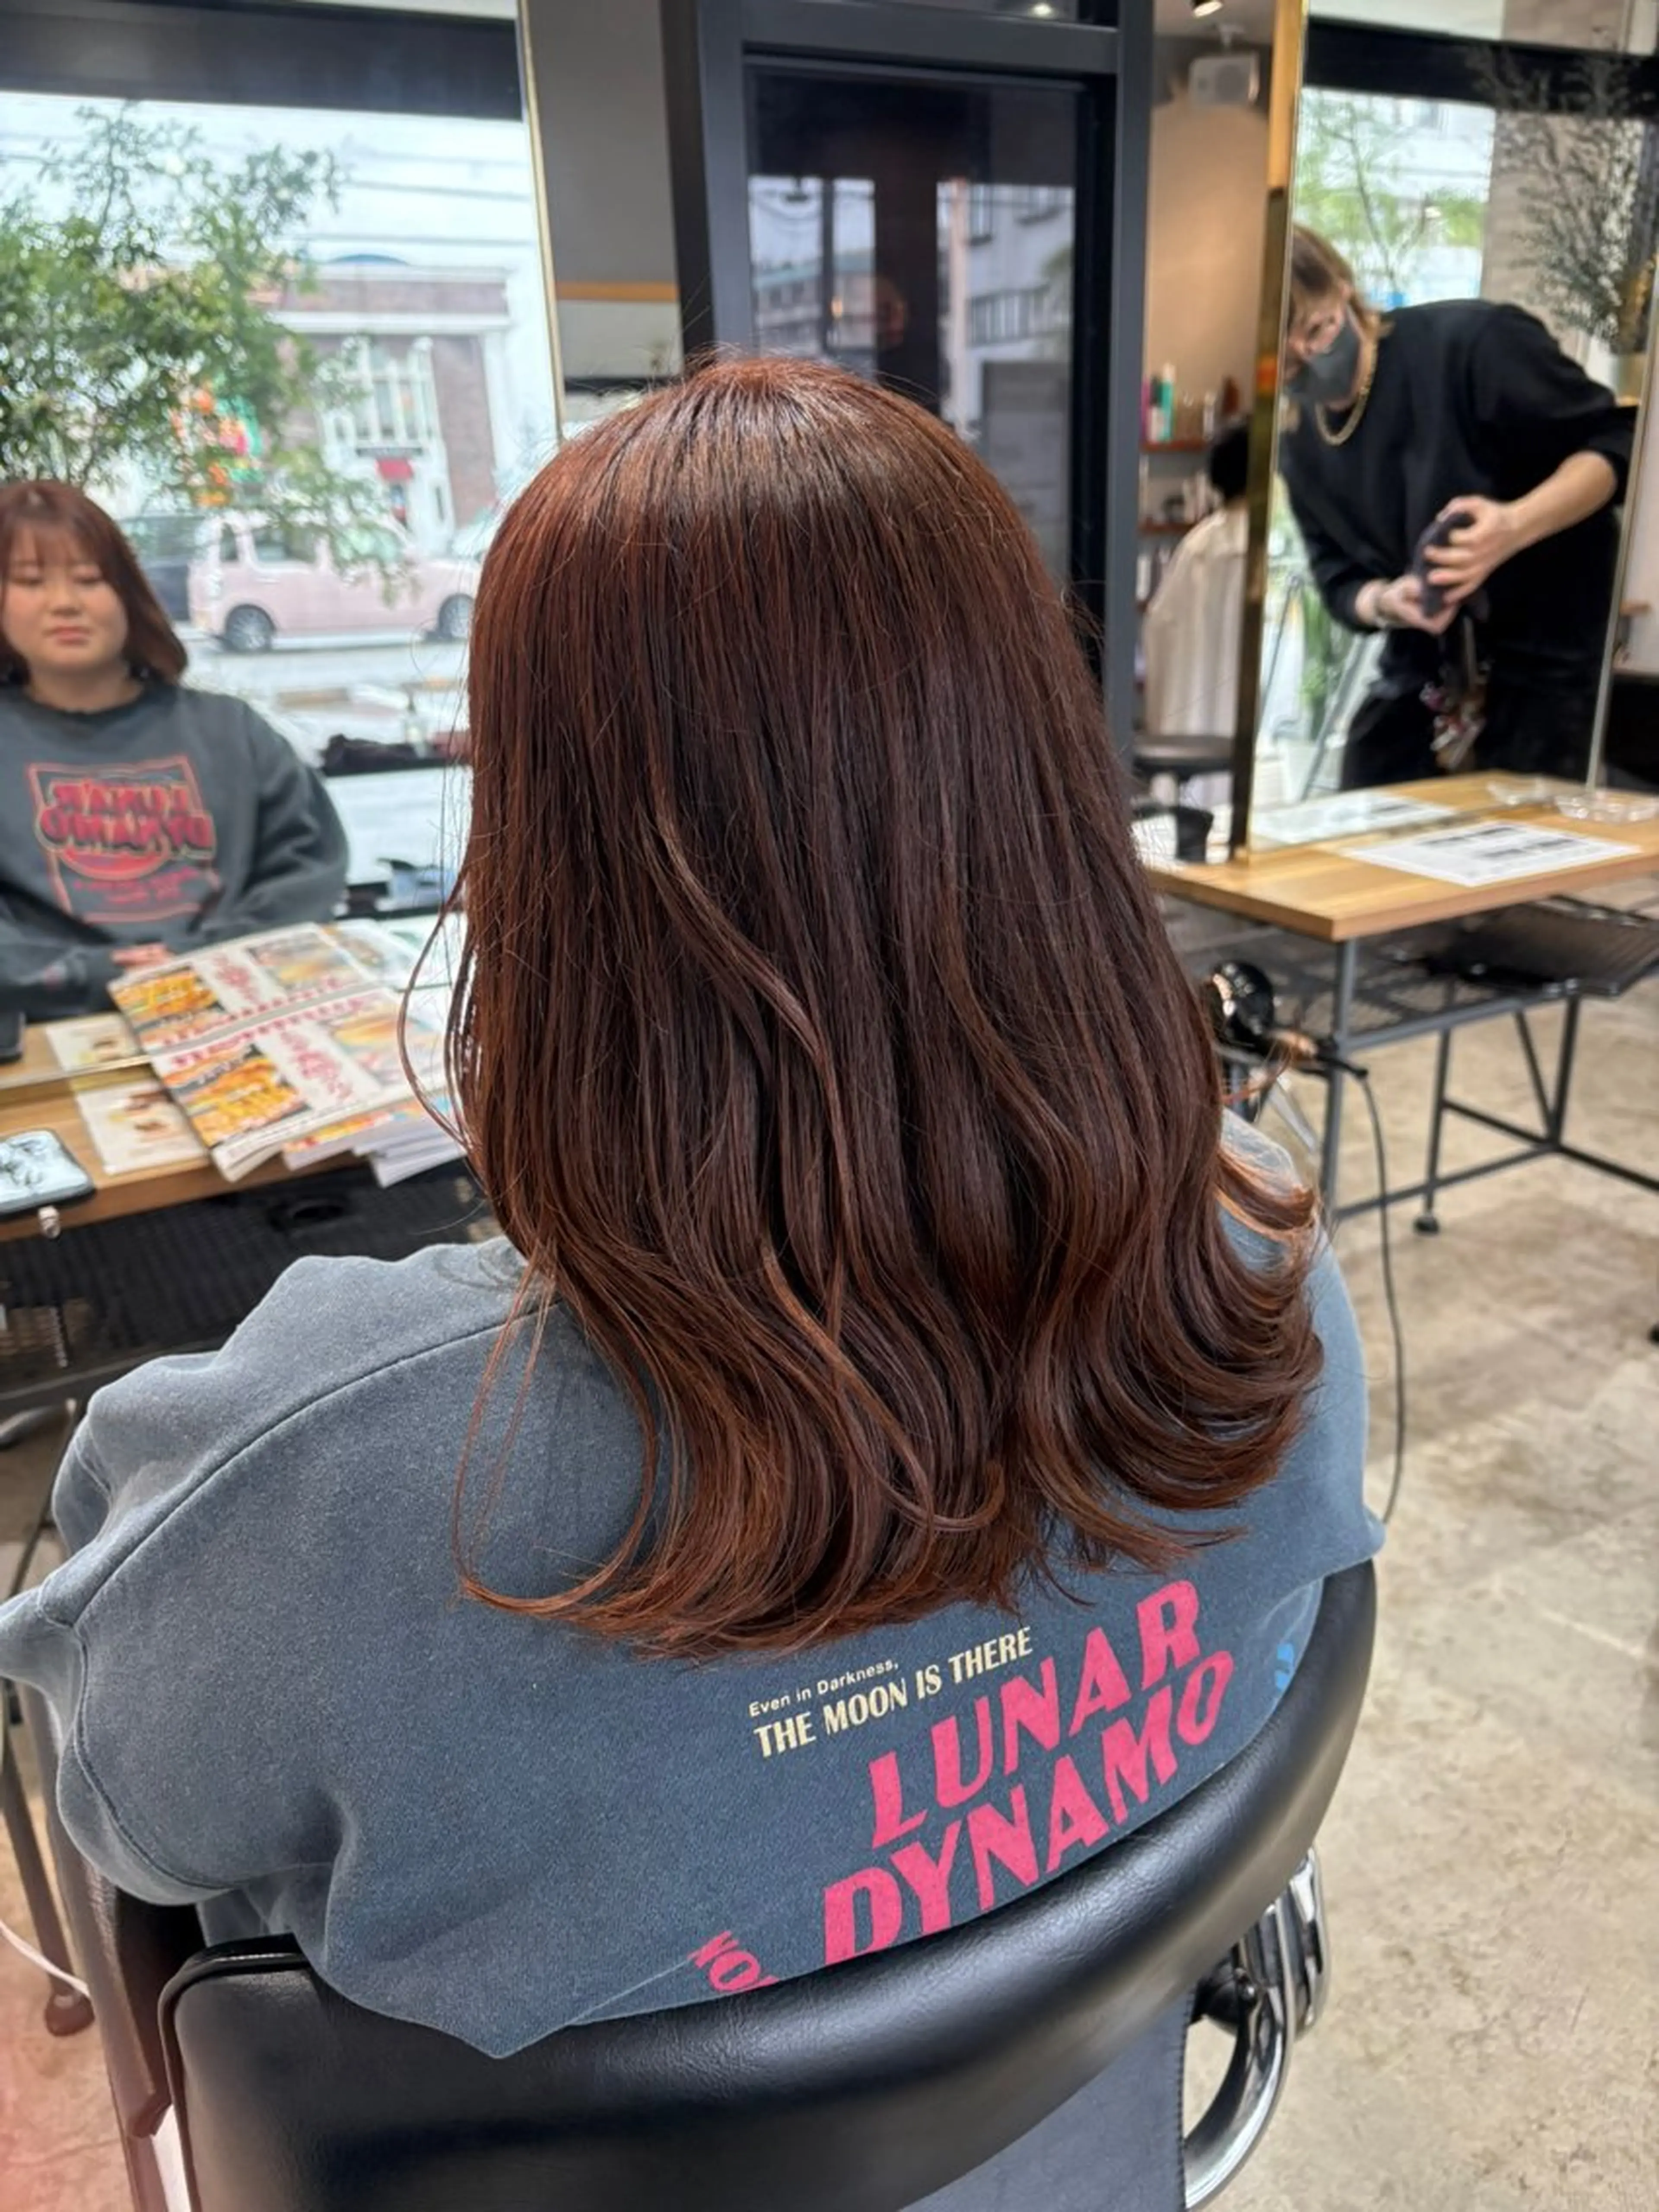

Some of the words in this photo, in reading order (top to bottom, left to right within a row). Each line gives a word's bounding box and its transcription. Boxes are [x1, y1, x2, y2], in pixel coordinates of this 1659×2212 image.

[749, 1693, 791, 1717] Even
[795, 1687, 812, 1702] in
[817, 1660, 899, 1695] Darkness,
[753, 1711, 816, 1758] THE
[823, 1678, 908, 1734] MOON
[915, 1665, 942, 1700] IS
[948, 1627, 1033, 1684] THERE
[868, 1580, 1200, 1849] LUNAR
[824, 1651, 1234, 1965] DYNAMO
